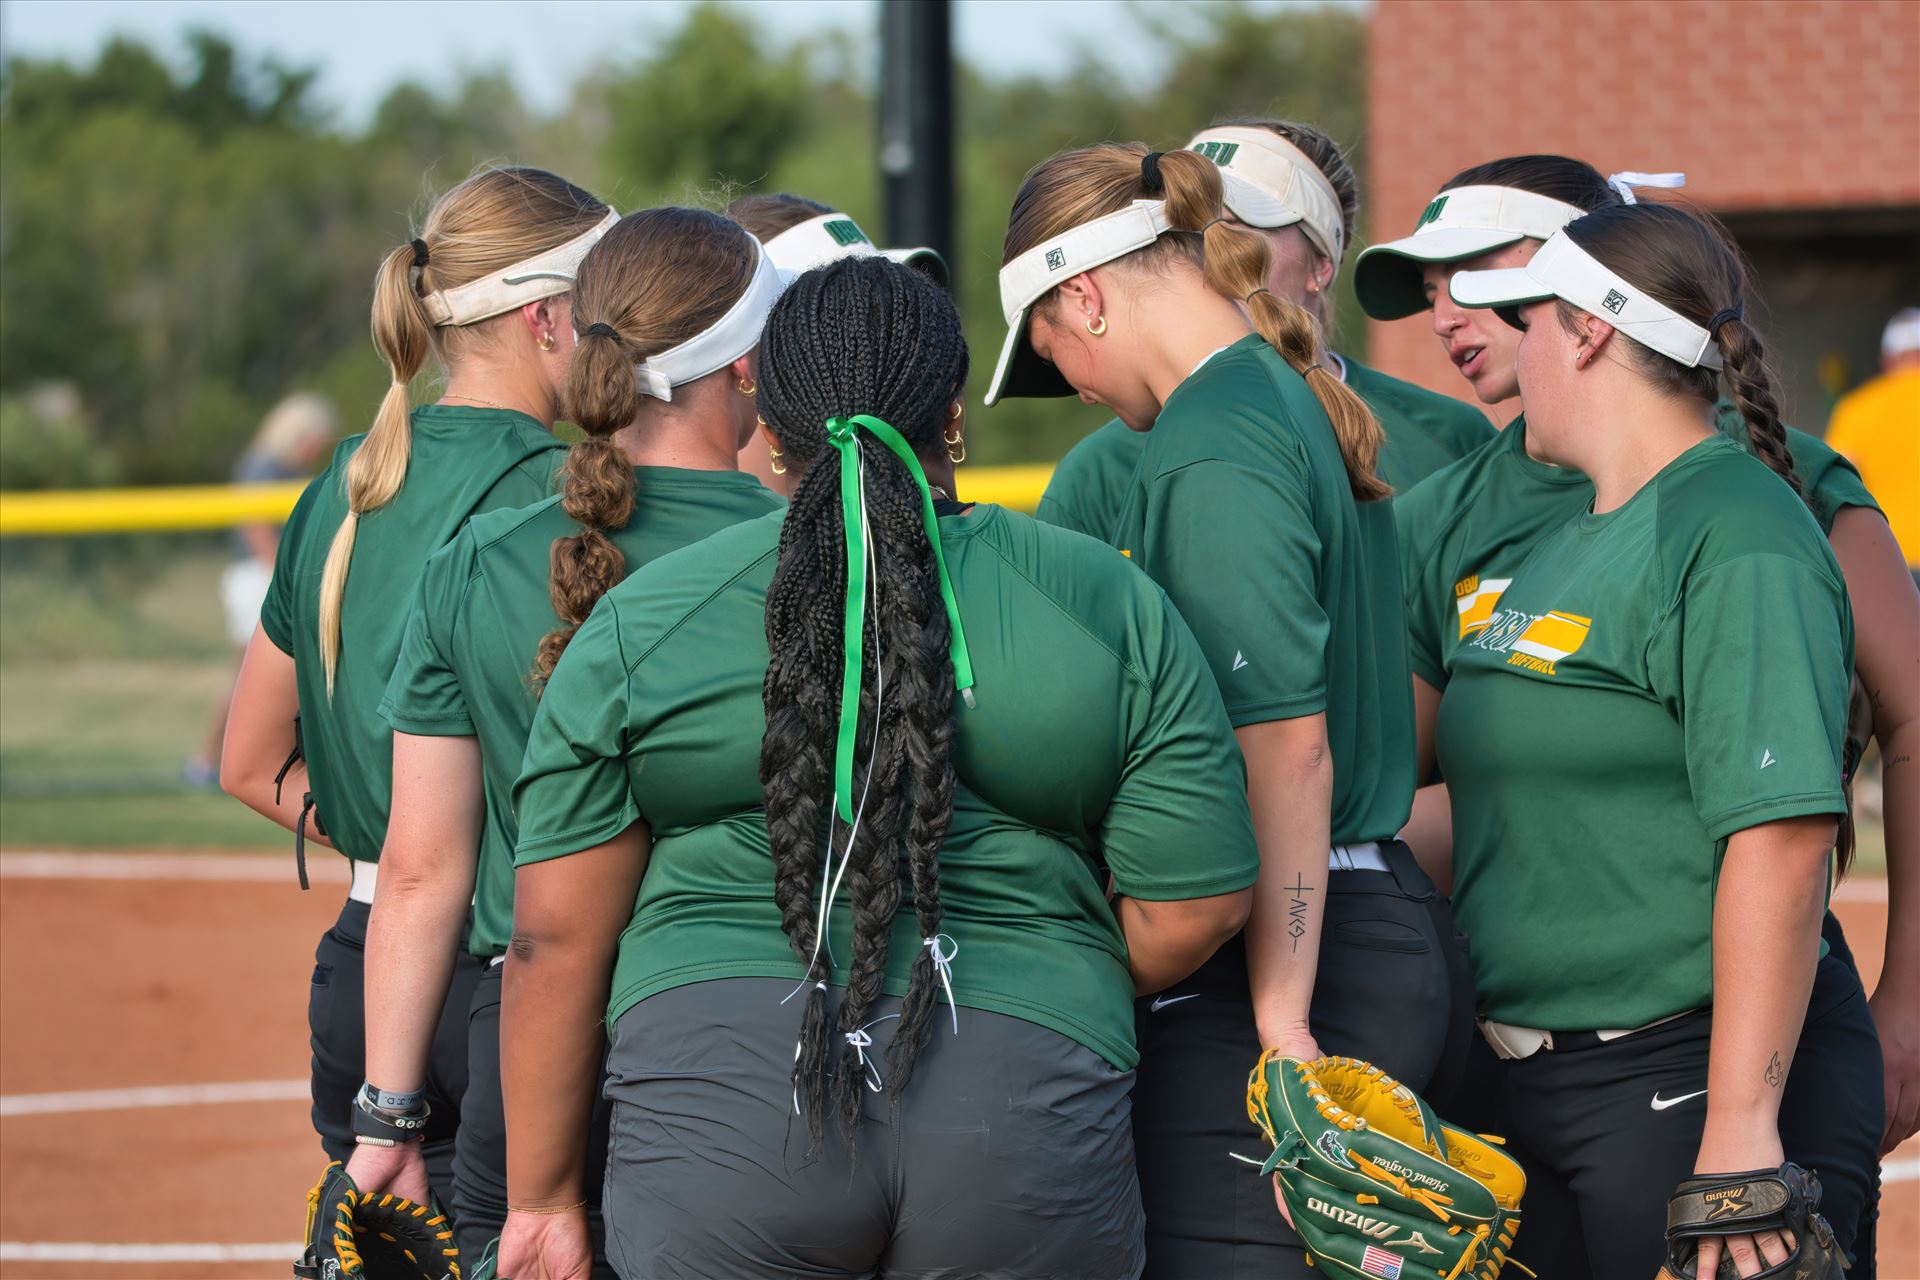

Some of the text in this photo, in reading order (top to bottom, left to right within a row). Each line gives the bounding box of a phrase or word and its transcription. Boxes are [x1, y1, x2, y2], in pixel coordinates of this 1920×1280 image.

[1507, 652, 1556, 676] SOFTBALL
[1372, 1155, 1449, 1192] Hand Crafted
